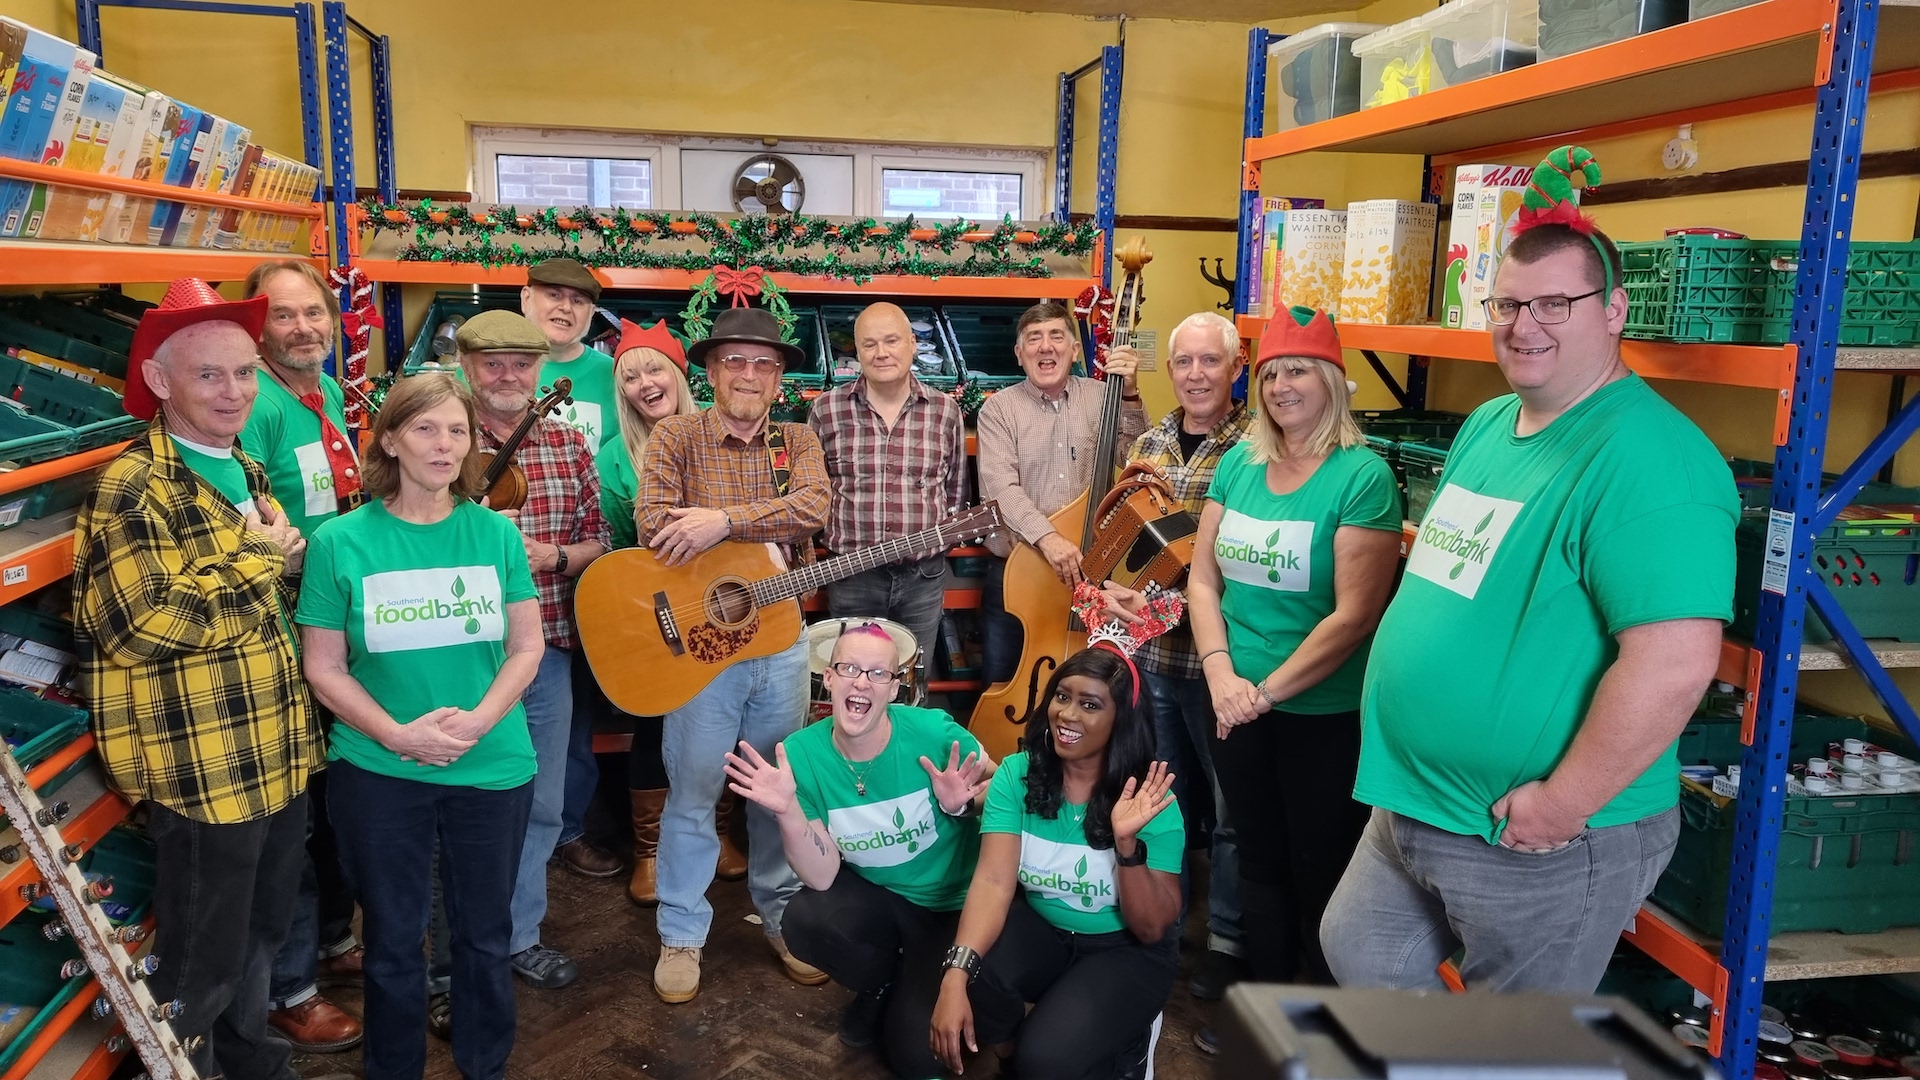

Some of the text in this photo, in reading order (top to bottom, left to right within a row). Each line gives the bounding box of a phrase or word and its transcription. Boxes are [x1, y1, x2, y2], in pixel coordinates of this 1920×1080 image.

[70, 81, 86, 95] CORN
[1457, 172, 1480, 184] Kellogg's
[1457, 192, 1476, 203] CORN
[1265, 199, 1289, 211] FREE
[1398, 204, 1436, 217] ESSENTIAL
[1457, 202, 1474, 210] FLAKES
[1291, 213, 1347, 223] ESSENTIA
[1397, 216, 1435, 229] WAITROSE
[1291, 224, 1347, 234] WAITROS
[1305, 241, 1339, 250] CORN
[1405, 236, 1426, 247] CORN
[1312, 252, 1346, 261] FLAKE
[1435, 516, 1459, 531] Southend
[1222, 535, 1246, 546] Southend
[1421, 518, 1490, 565] foodbank
[1215, 536, 1300, 571] foodbank
[386, 597, 425, 607] Southend
[373, 595, 496, 625] foodbank
[836, 820, 930, 852] foodbank
[843, 830, 873, 841] Southend
[1022, 861, 1051, 875] Southend
[1018, 869, 1112, 897] oodbank
